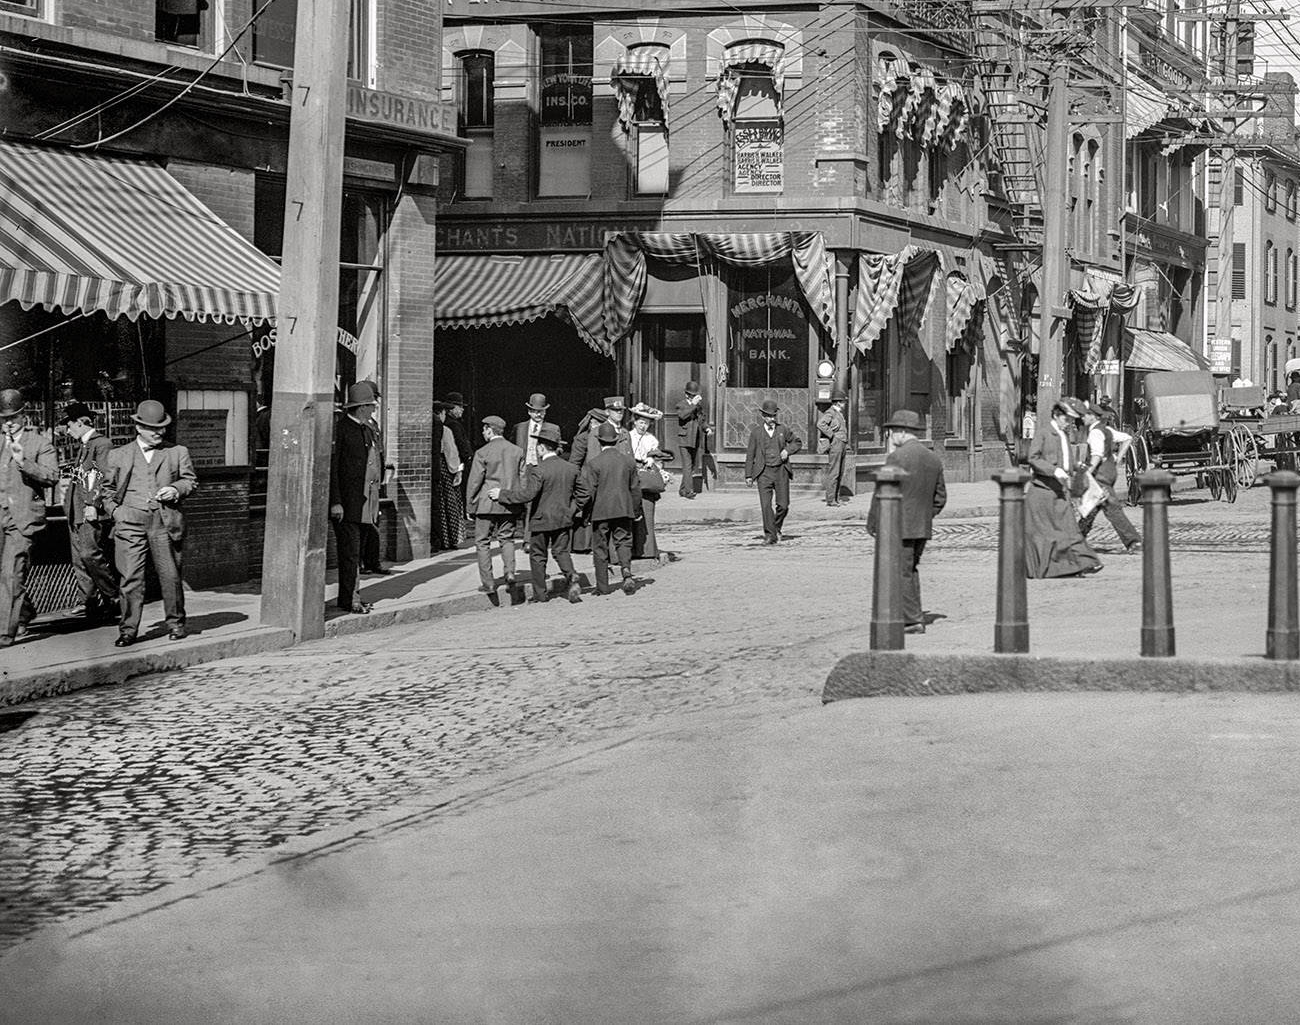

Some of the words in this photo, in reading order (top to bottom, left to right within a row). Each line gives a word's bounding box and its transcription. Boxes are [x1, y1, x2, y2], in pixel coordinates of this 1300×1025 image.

[349, 87, 455, 133] INSURANCE.
[545, 139, 587, 148] PRESIDENT
[436, 225, 519, 247] CHANTS
[742, 328, 797, 340] NATIONAL
[252, 328, 277, 359] BOS
[749, 349, 791, 361] BANK.
